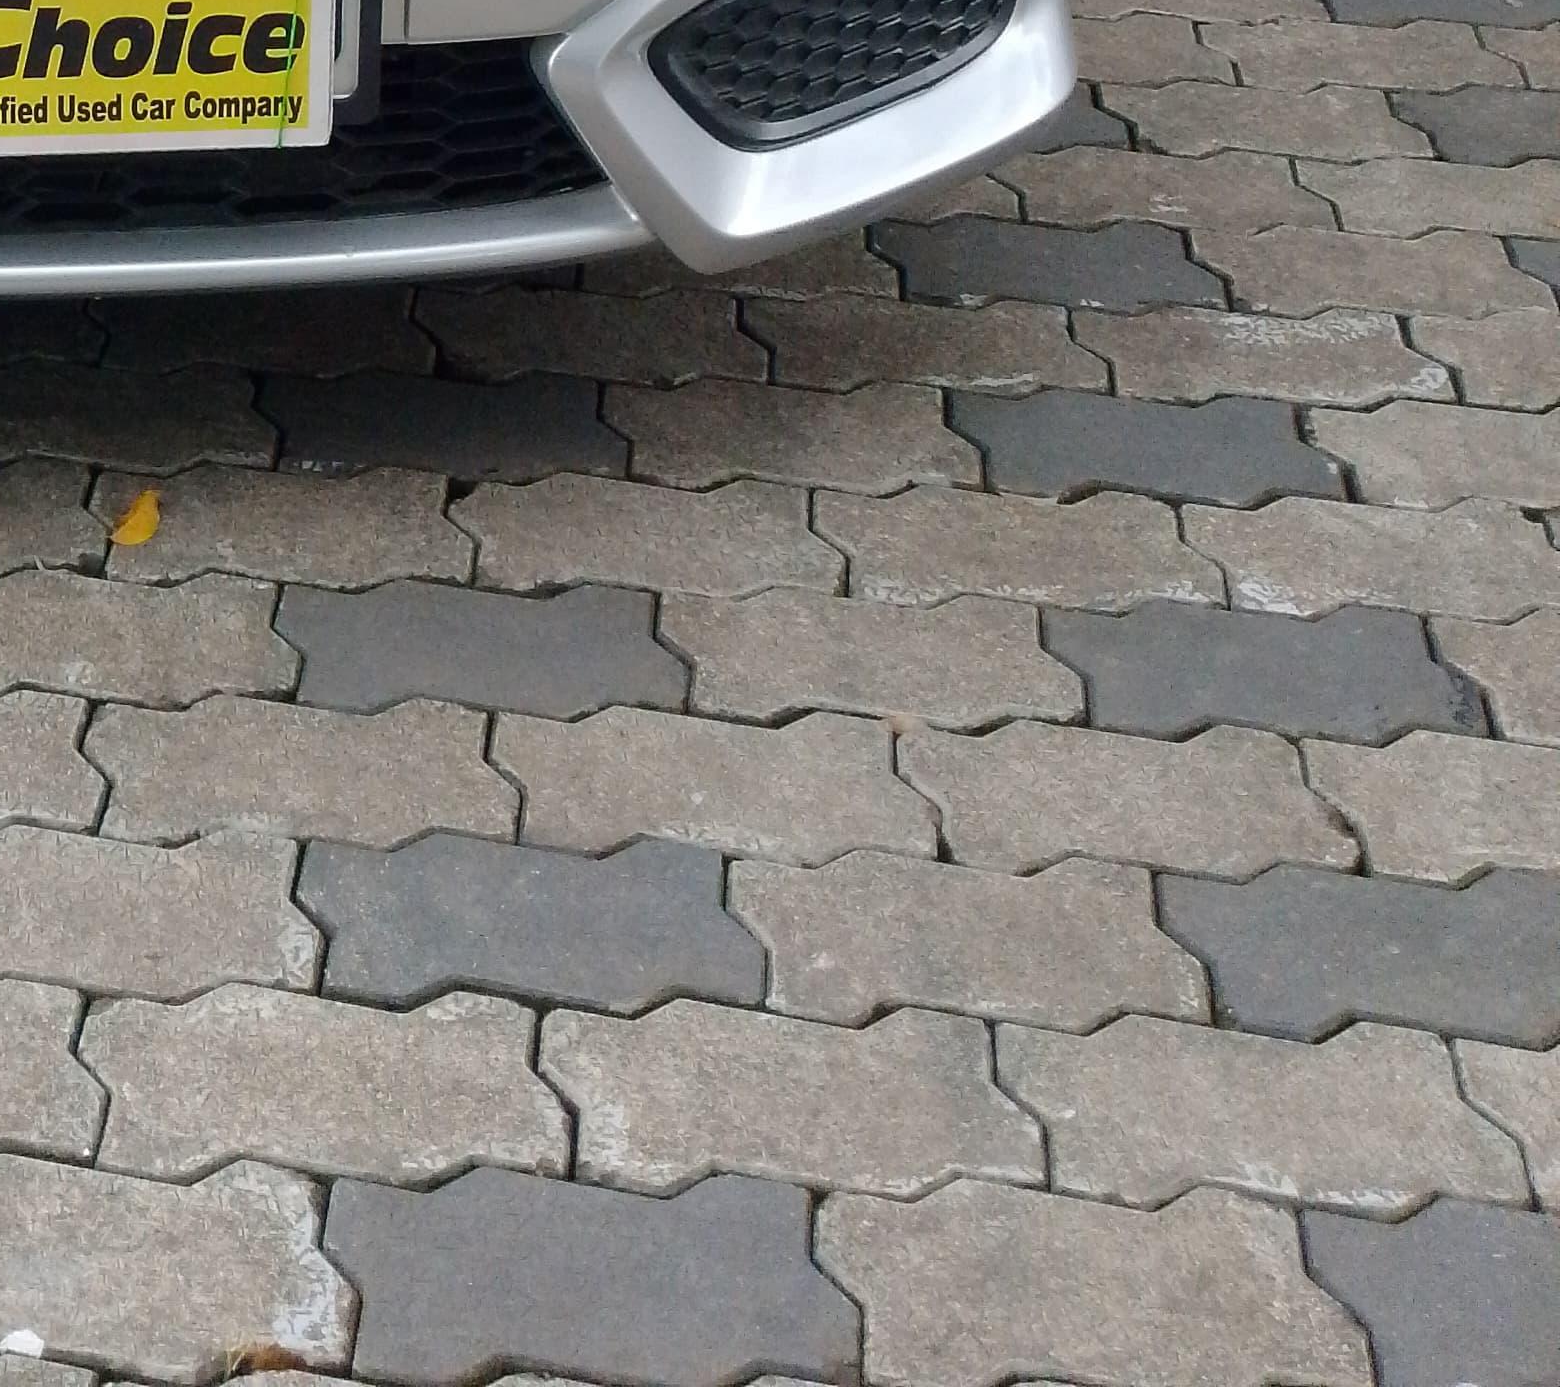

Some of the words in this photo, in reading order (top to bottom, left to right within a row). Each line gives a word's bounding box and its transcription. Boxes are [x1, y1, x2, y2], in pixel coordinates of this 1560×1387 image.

[57, 93, 122, 123] Used
[132, 92, 175, 120] Car
[184, 90, 303, 124] Company
